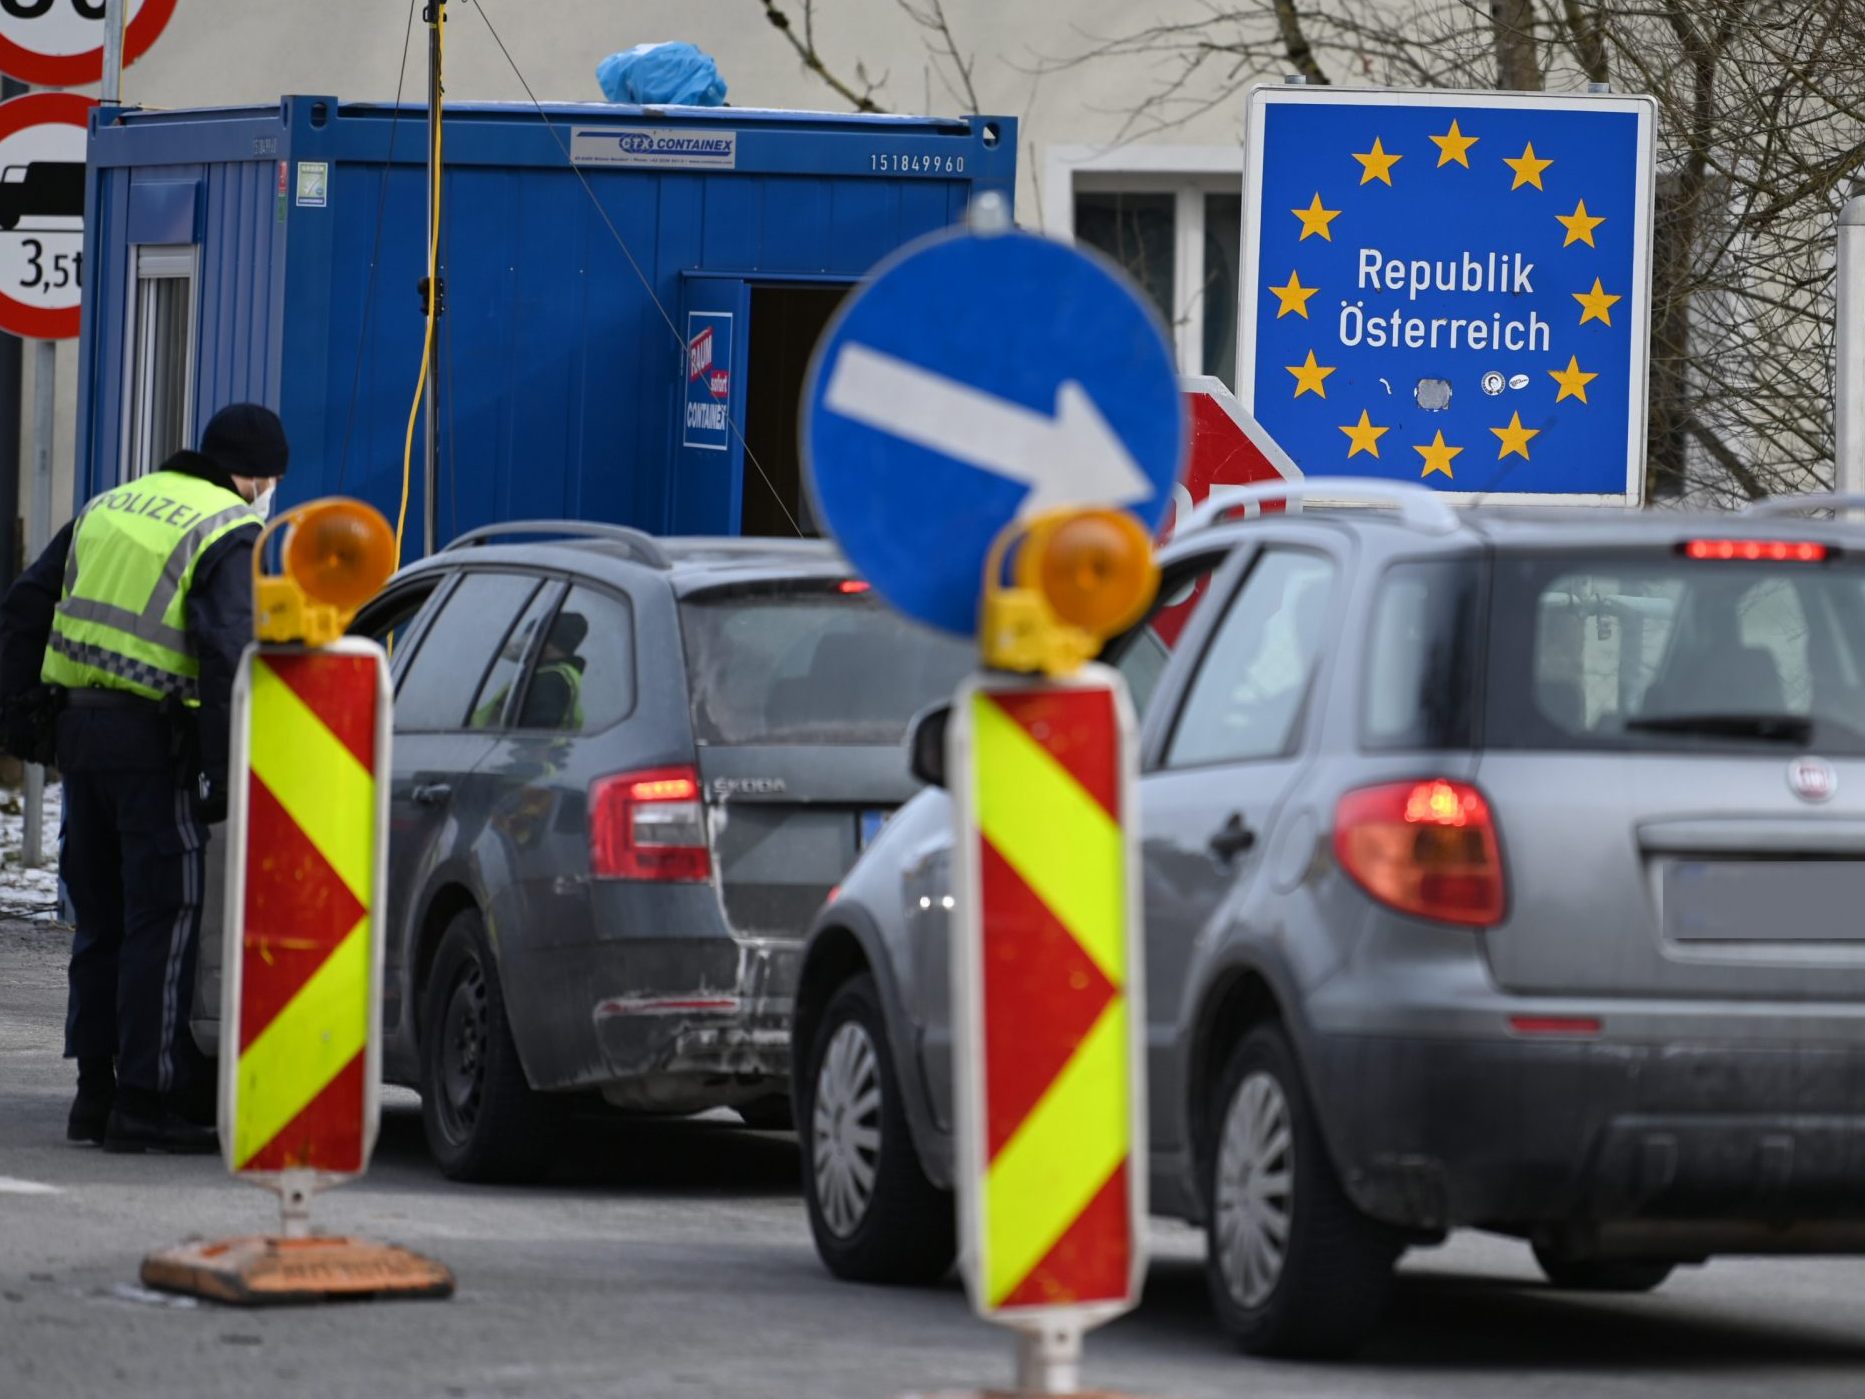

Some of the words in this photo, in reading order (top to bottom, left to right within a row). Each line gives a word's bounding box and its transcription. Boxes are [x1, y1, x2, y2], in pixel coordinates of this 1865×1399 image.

[657, 138, 733, 151] CONTAINEX
[871, 154, 964, 172] 151849960
[1358, 248, 1534, 300] Republik
[1339, 300, 1550, 351] Österreich
[686, 401, 726, 430] CONTAINEX
[91, 492, 202, 528] POLIZEI
